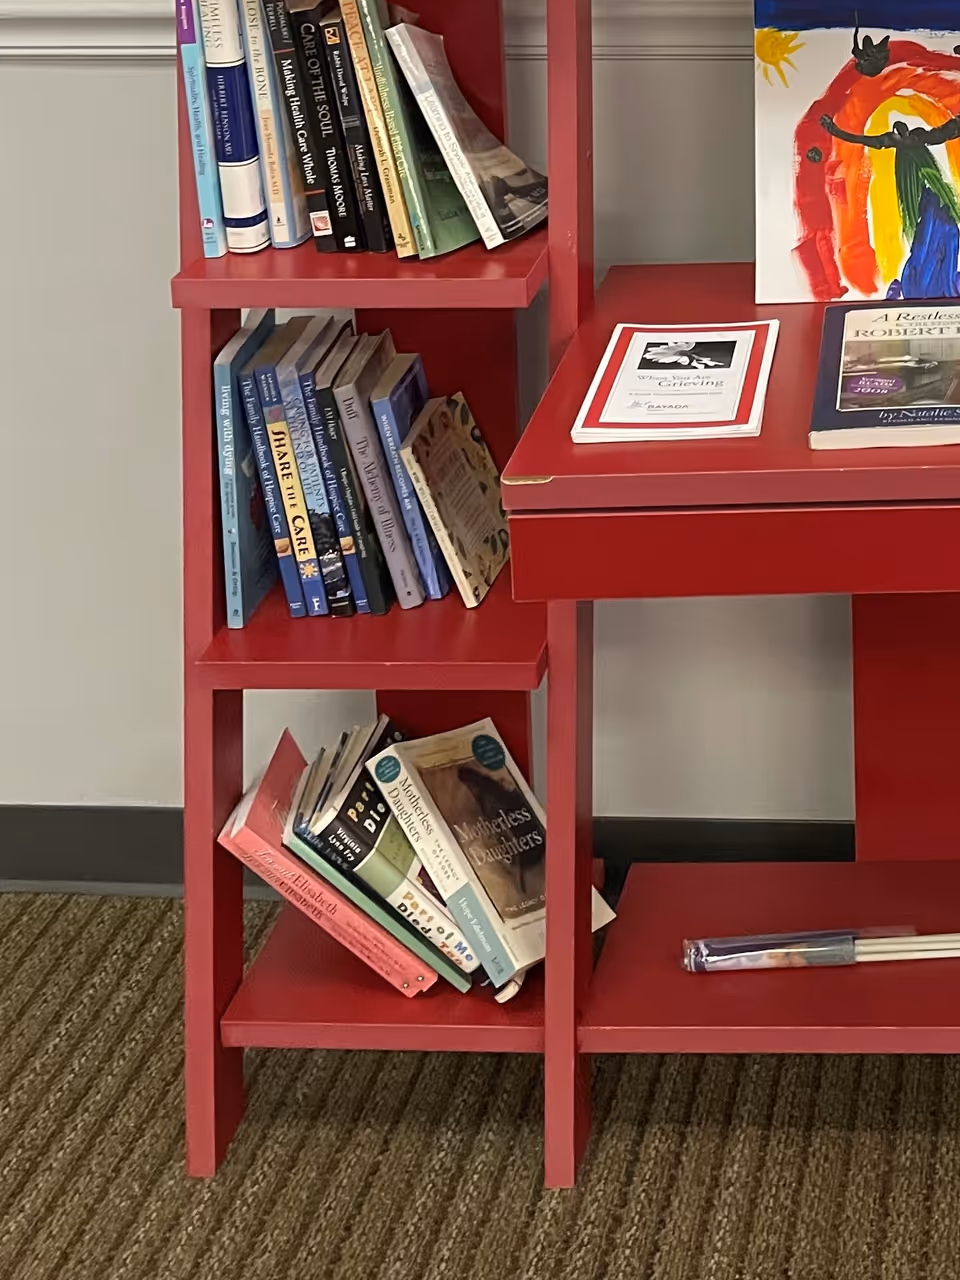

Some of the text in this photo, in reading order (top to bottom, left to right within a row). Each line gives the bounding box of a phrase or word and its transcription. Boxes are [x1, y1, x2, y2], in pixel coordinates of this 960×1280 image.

[266, 3, 278, 31] FERRELL
[250, 36, 258, 45] to
[252, 48, 263, 63] the
[342, 2, 369, 73] PEACE AT
[255, 66, 269, 101] BONE
[300, 23, 334, 138] CARE OF THE SOUL
[333, 50, 349, 106] Rabbi David Wolpe
[281, 59, 317, 185] Making Health Care Whole
[354, 144, 366, 171] Making
[396, 159, 407, 178] Care
[325, 146, 347, 217] THOMAS MOORE
[360, 172, 370, 187] Loss
[383, 167, 395, 204] Grassman
[363, 187, 374, 212] Matter
[853, 326, 949, 338] ROBERT
[872, 313, 889, 322] A
[896, 311, 960, 322] Restless
[221, 385, 232, 416] living
[658, 380, 724, 388] Grieving
[342, 396, 359, 420] Duff
[878, 411, 898, 420] by
[900, 408, 951, 418] Natalie
[223, 419, 233, 442] with
[222, 444, 234, 476] dying
[242, 378, 282, 533] The Family Handbook of Hospice Care
[292, 397, 326, 508] CARING FOR PATIENTS
[294, 442, 314, 496] END OF LIFE
[303, 380, 346, 532] The Family Handbook of Hospice Care
[380, 414, 413, 511] WHEN BREATH BECOMES AIR
[271, 430, 310, 556] SHARE THE CARE
[355, 435, 397, 554] The Alchemy of Illness
[347, 782, 375, 823] Part
[387, 786, 422, 843] Daughters
[398, 776, 434, 836] Motherless
[328, 835, 344, 851] Lynn
[336, 827, 361, 854] Virginia
[453, 806, 532, 843] Motherless
[431, 848, 452, 880] OF LOSS
[434, 838, 444, 854] THE
[441, 851, 461, 881] LEGACY
[468, 829, 544, 867] Daughters
[291, 874, 339, 917] Elisabeth
[397, 902, 433, 939] Died,
[439, 940, 463, 966] Too
[402, 891, 474, 962] Part of Me
[458, 897, 492, 953] Hope Edelman
